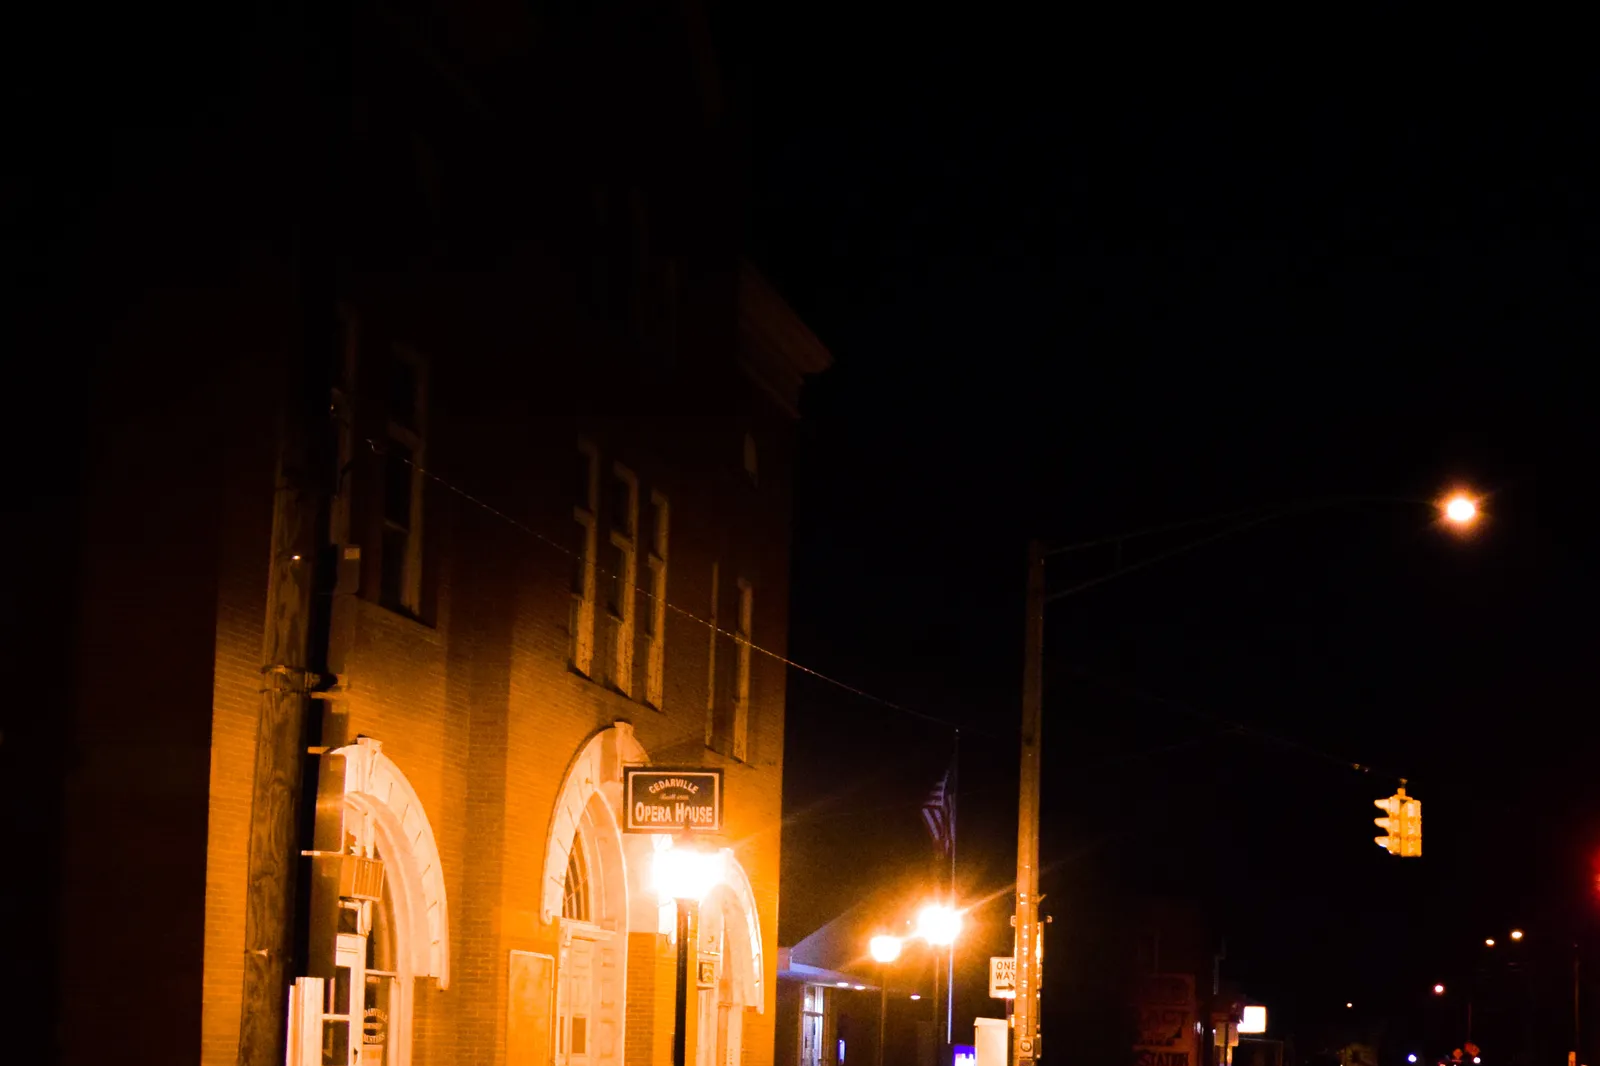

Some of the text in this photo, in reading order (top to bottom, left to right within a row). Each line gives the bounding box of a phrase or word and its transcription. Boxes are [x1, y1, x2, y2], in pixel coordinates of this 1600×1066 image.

[648, 778, 699, 794] CEDARVILLE
[635, 801, 713, 823] OPERA HOUSE
[996, 961, 1016, 970] ONE
[996, 971, 1016, 980] WAY
